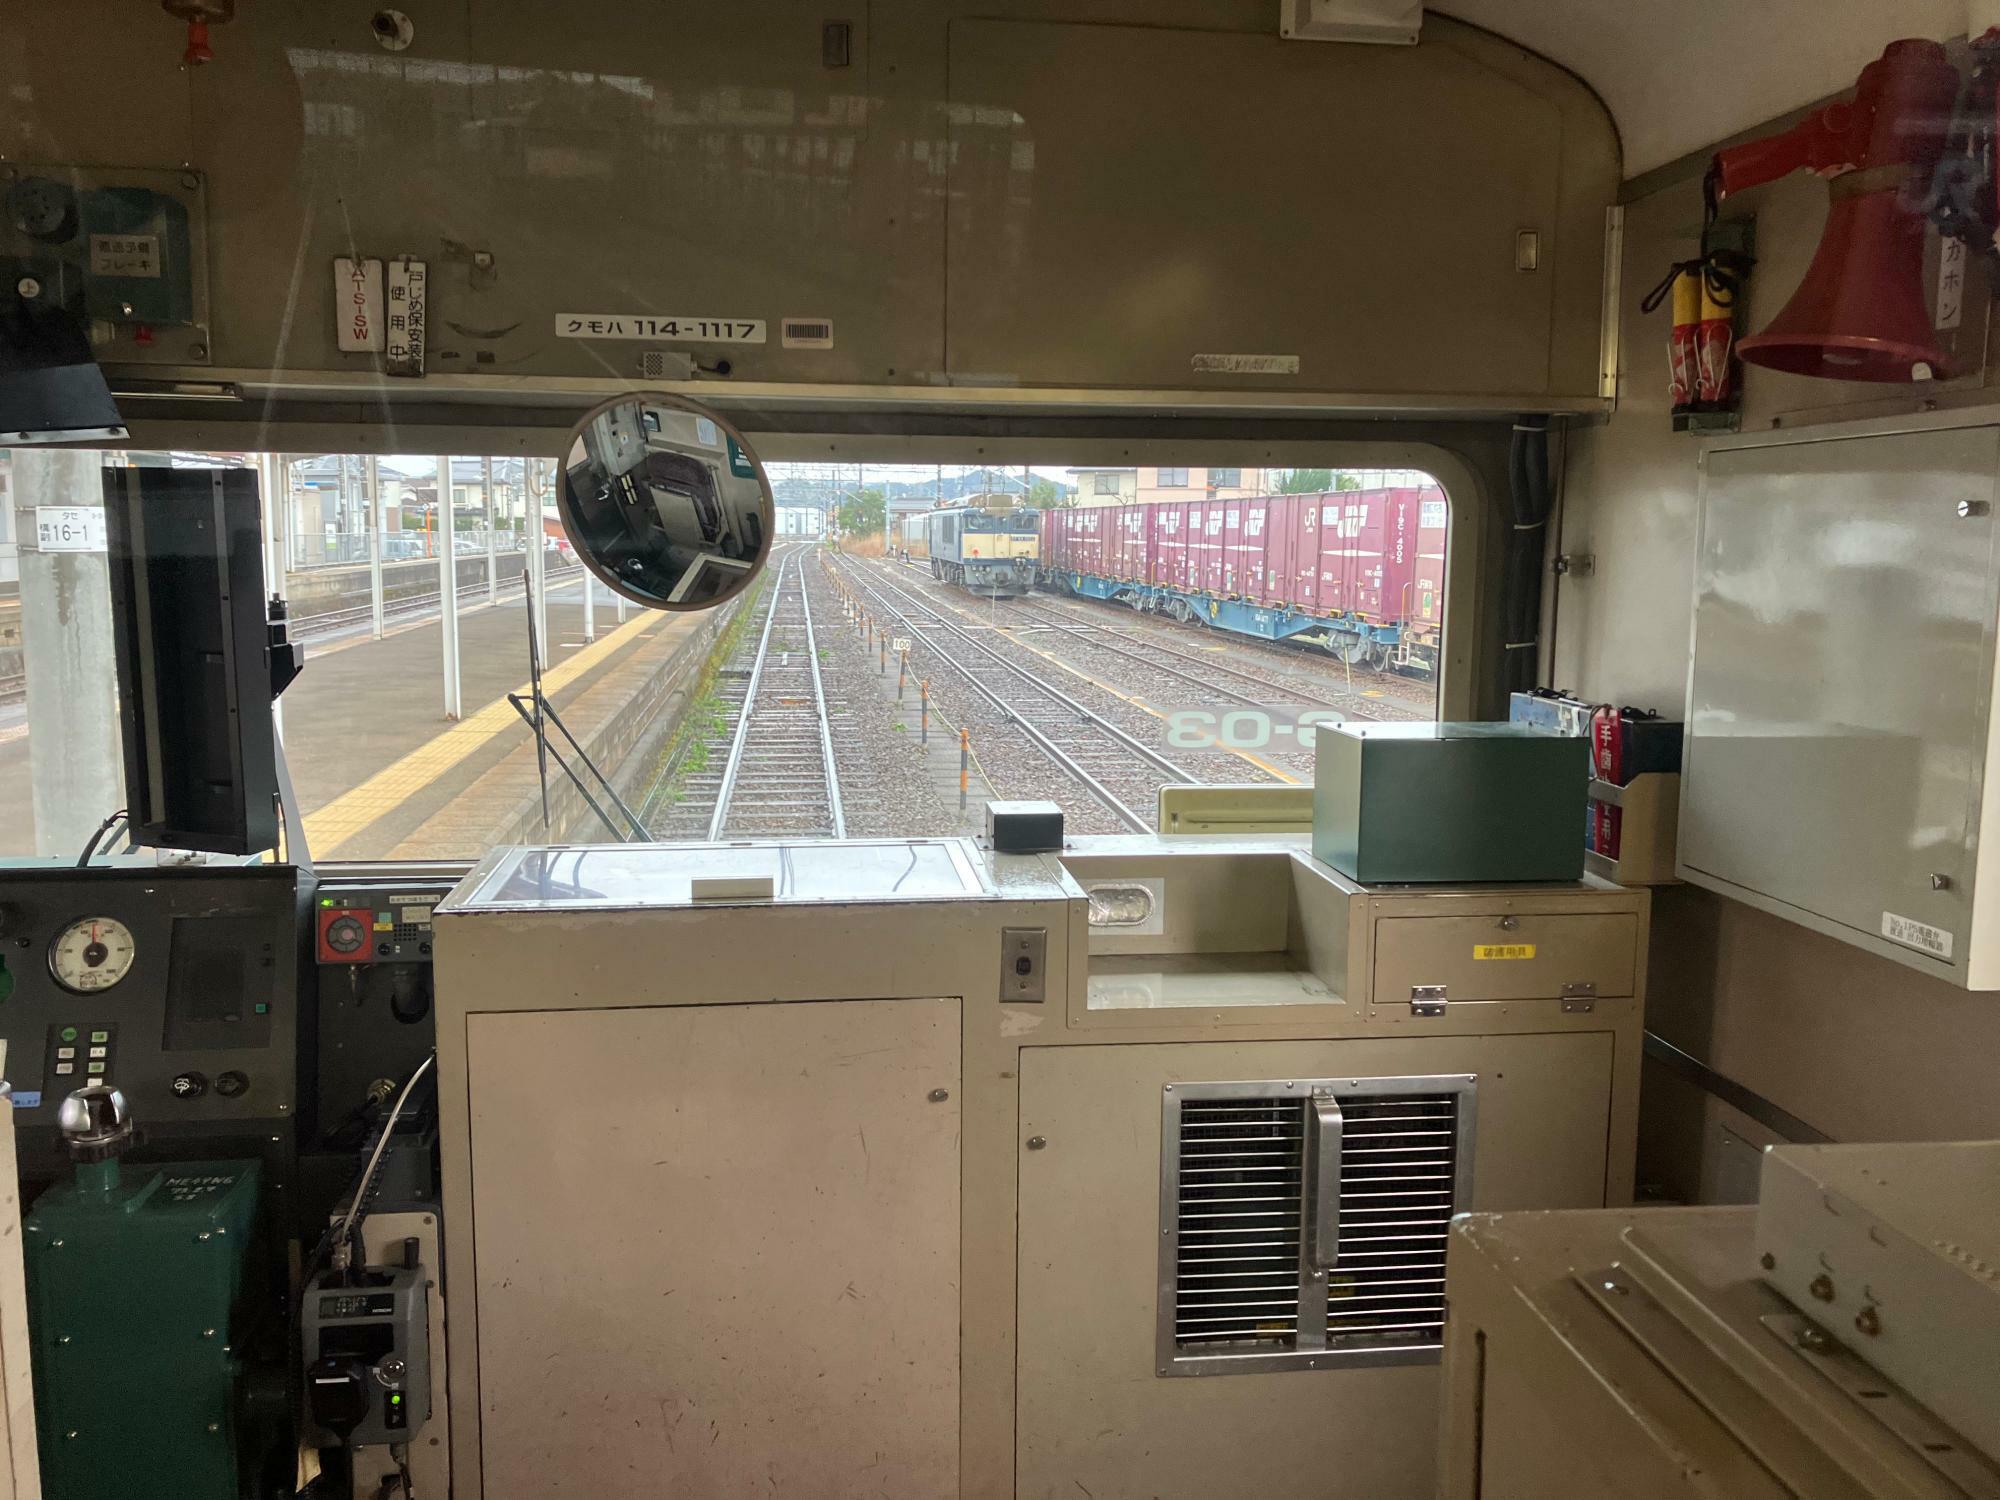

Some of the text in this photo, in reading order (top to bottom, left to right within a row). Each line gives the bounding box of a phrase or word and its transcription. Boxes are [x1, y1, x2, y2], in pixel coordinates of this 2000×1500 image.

[391, 286, 405, 359] 使用中
[567, 320, 756, 339] クモハ 114-1117
[54, 524, 88, 541] 16-1
[895, 640, 910, 649] 100
